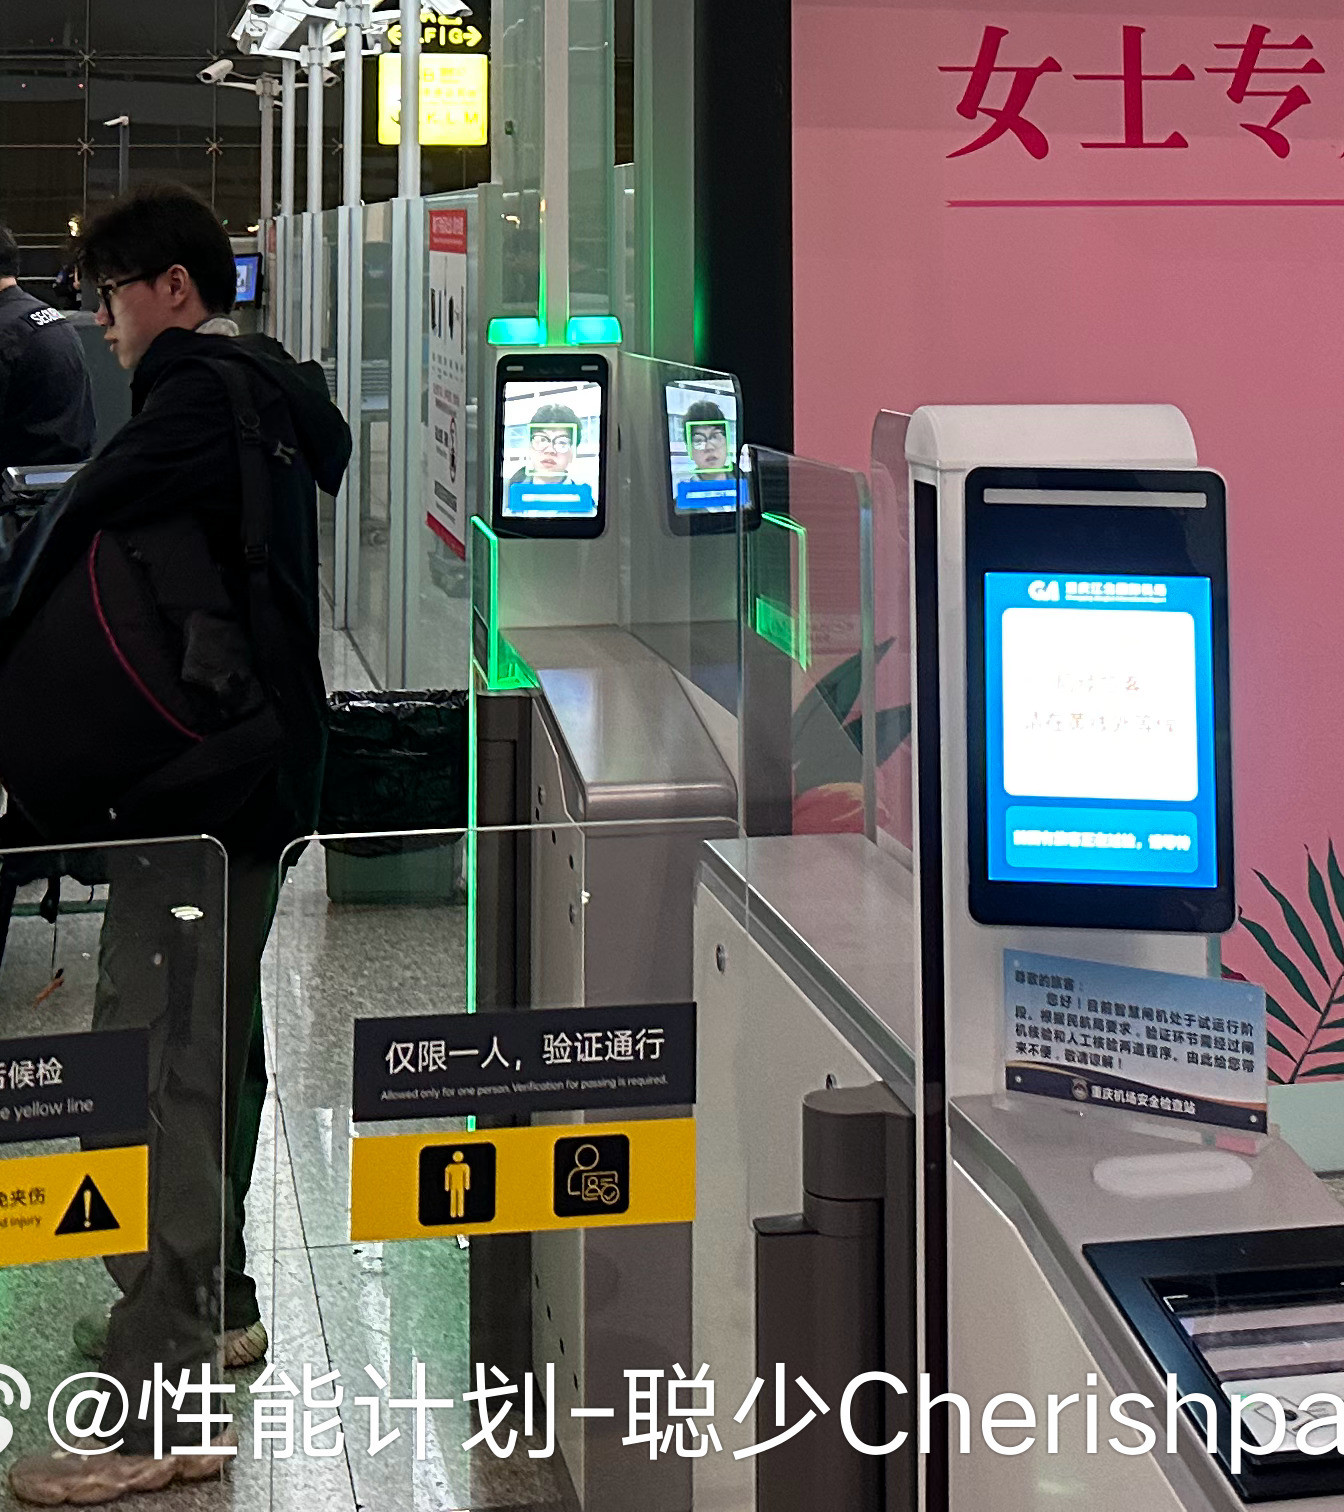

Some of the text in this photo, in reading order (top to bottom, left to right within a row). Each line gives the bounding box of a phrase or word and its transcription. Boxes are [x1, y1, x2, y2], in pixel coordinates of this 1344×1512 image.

[385, 1028, 664, 1075] 仅限一人，验证通行
[13, 1099, 63, 1122] yellow
[67, 1097, 94, 1114] line
